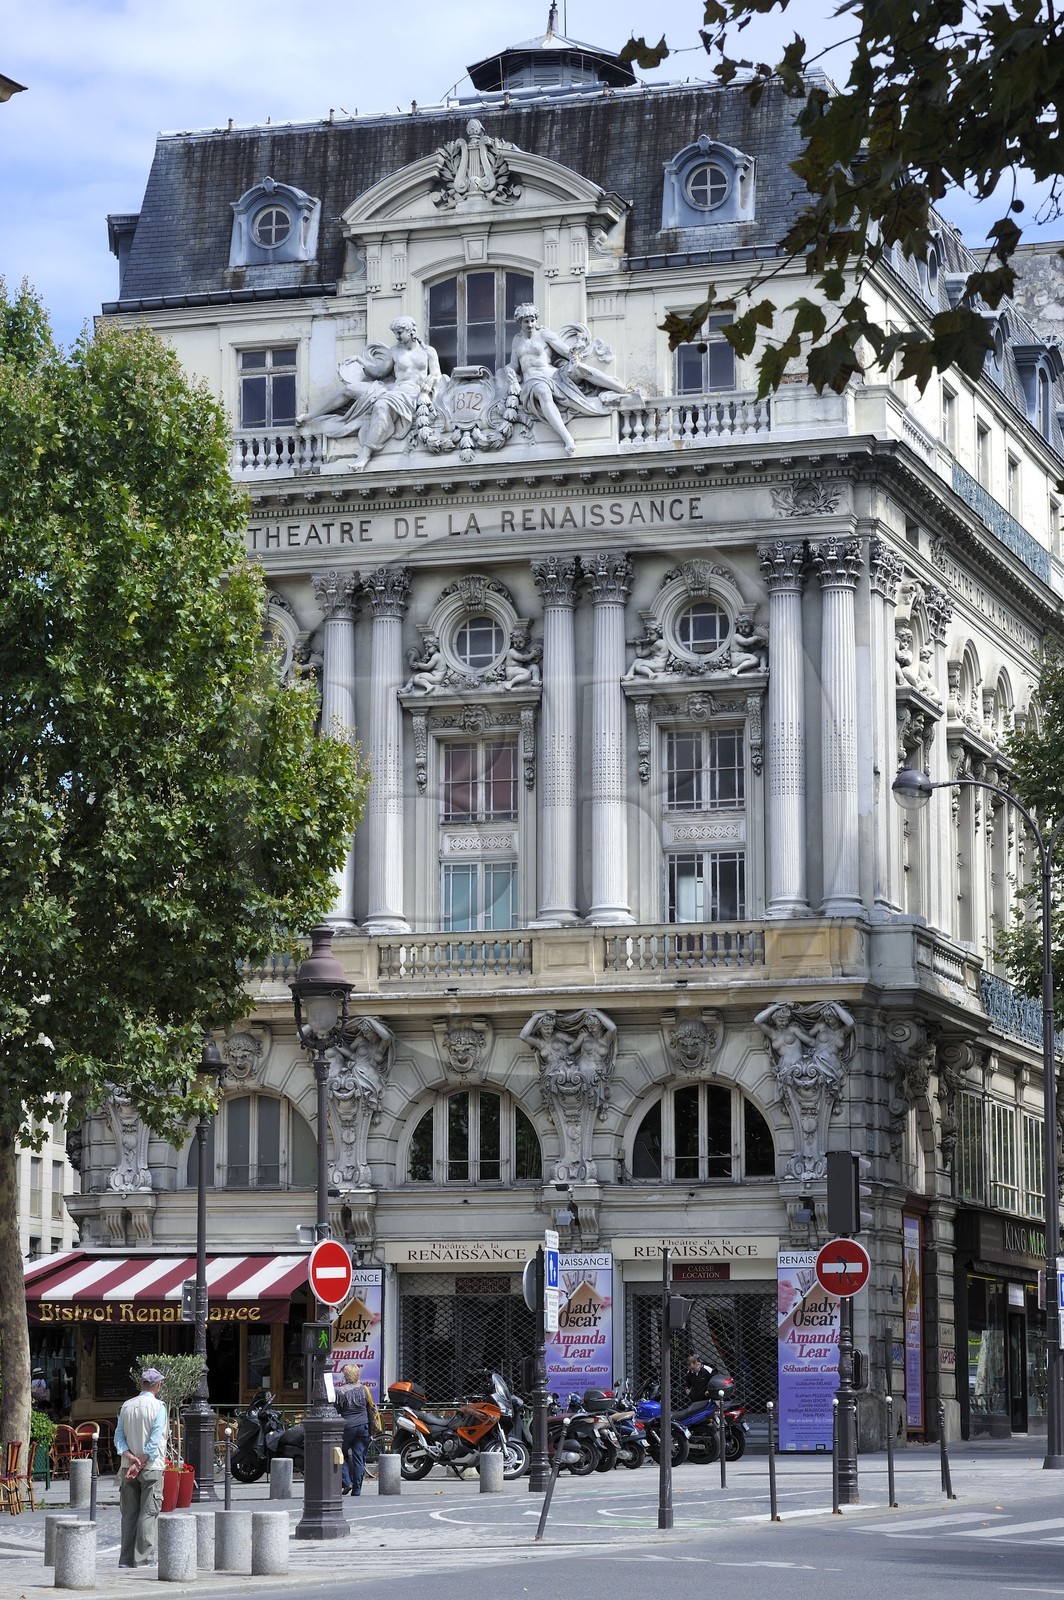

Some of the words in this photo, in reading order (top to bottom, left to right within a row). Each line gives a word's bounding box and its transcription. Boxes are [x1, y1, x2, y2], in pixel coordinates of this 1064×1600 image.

[451, 391, 484, 414] 1872
[248, 519, 374, 551] THEATRE
[394, 515, 429, 541] DE
[447, 511, 483, 538] LA
[500, 497, 704, 533] RENAISSANCE
[1005, 1221, 1026, 1253] KING
[408, 1249, 527, 1260] RENAISSANCE
[38, 1303, 113, 1322] Bistrot
[119, 1303, 261, 1322] Renaiance
[567, 1298, 601, 1316] Lady
[802, 1297, 837, 1314] Lady
[337, 1314, 371, 1333] Lady
[559, 1310, 601, 1327] Oscar
[793, 1309, 838, 1326] Oscar
[550, 1329, 606, 1344] Amanda
[785, 1329, 842, 1344] Amanda
[331, 1345, 375, 1360] manda
[562, 1345, 595, 1358] Lear
[797, 1344, 831, 1358] Lear
[548, 1365, 583, 1373] Sébastien
[584, 1365, 609, 1373] Castro
[782, 1365, 819, 1373] Sébastien
